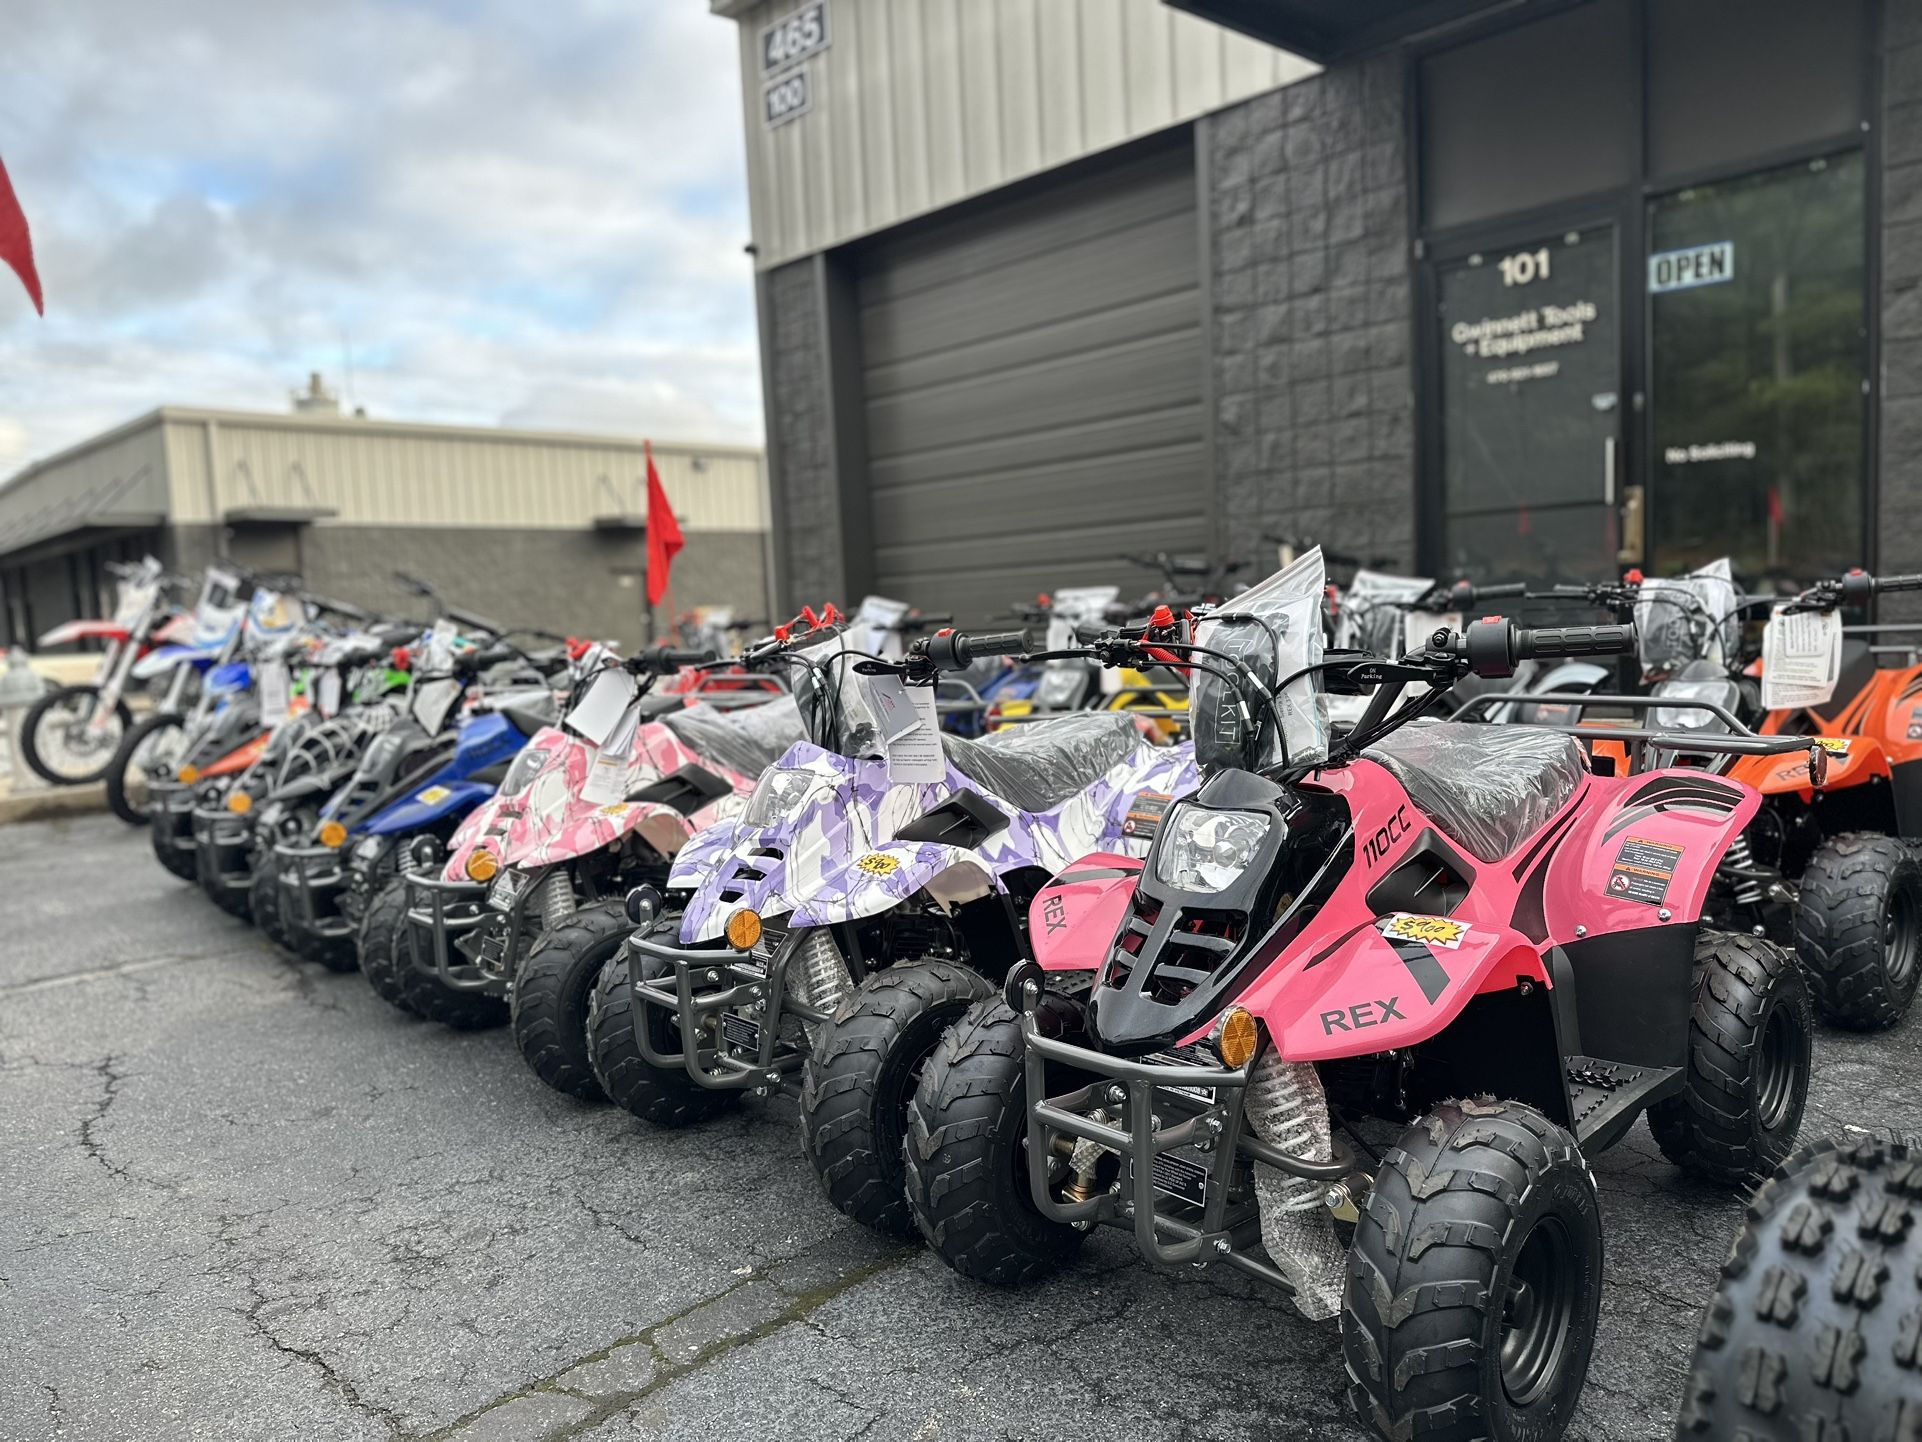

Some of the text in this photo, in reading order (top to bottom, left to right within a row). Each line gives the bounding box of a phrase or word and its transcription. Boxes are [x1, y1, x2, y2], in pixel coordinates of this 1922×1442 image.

[768, 9, 821, 61] 465
[1498, 247, 1550, 286] 101
[1656, 247, 1724, 286] OPEN
[1540, 300, 1597, 328] Tools
[1478, 322, 1584, 358] Equipment
[1776, 763, 1809, 782] RE
[1363, 804, 1411, 869] 110CC
[1043, 894, 1067, 935] REX
[1400, 919, 1446, 933] $900
[1320, 996, 1407, 1036] REX
